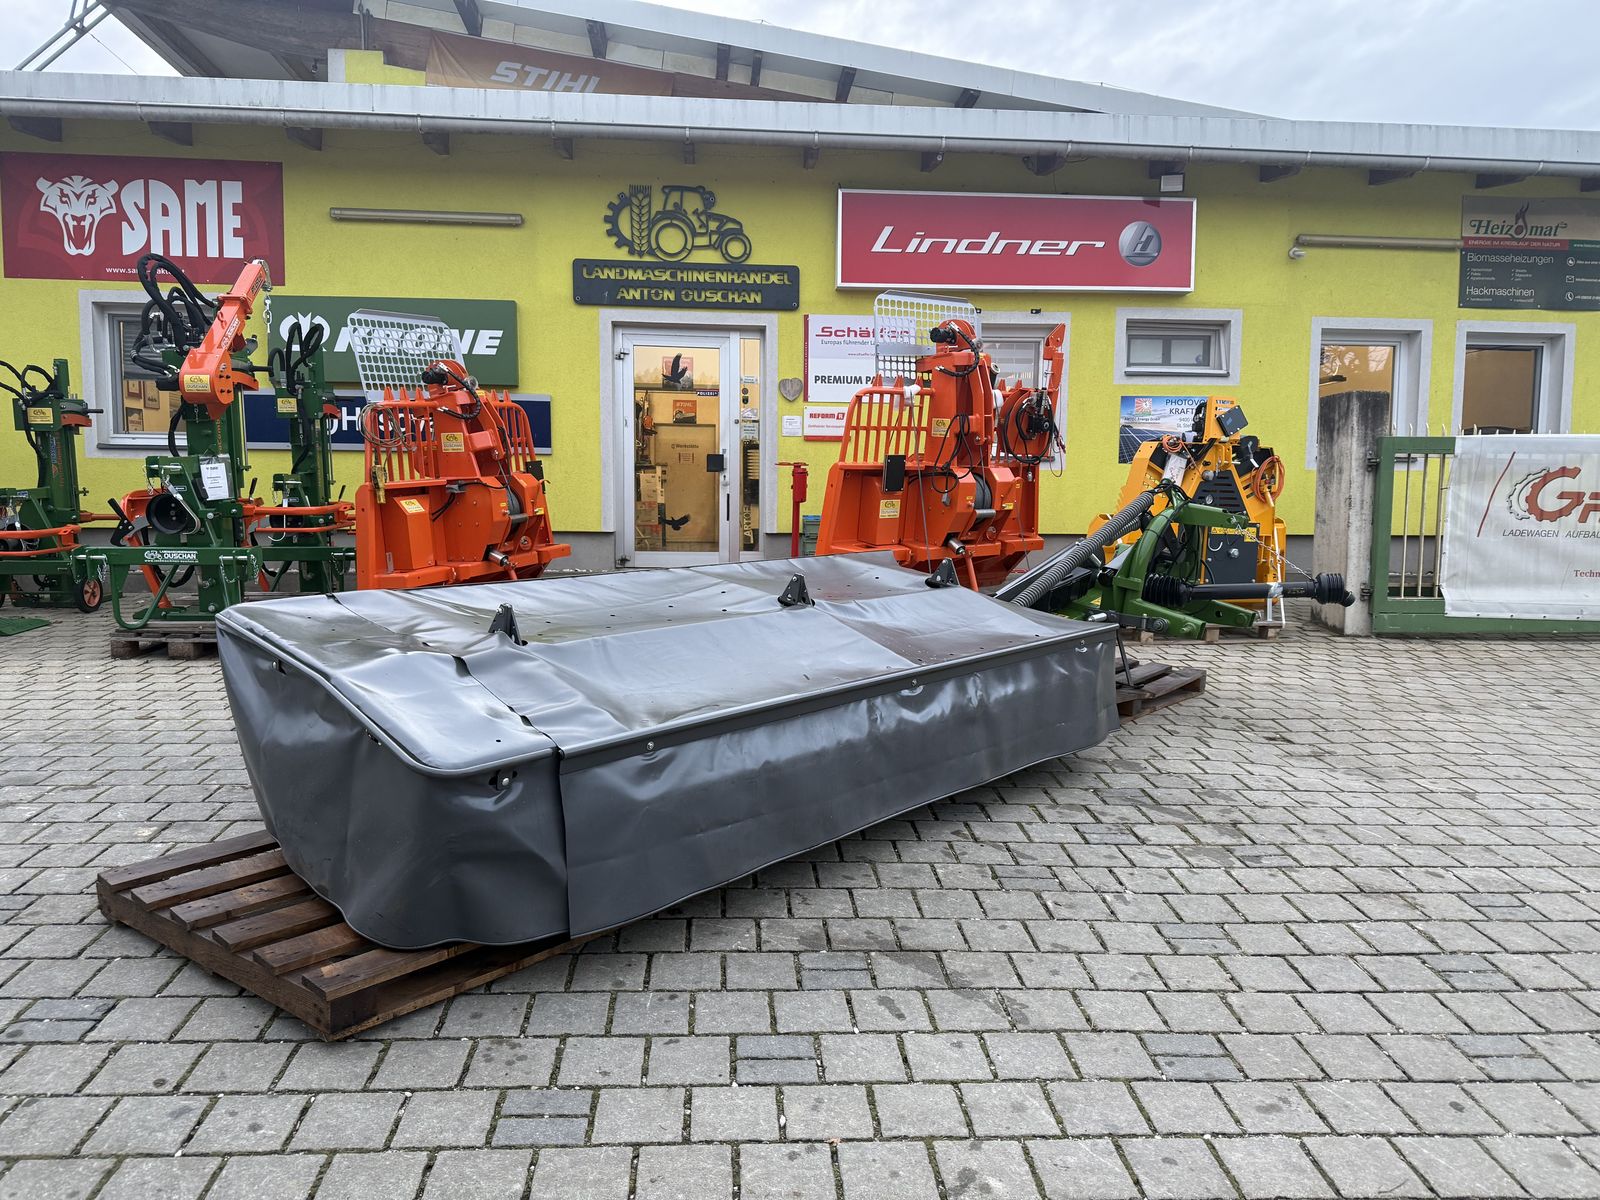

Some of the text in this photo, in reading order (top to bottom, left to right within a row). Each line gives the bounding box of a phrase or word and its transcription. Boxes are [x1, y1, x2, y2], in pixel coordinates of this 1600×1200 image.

[489, 60, 600, 93] STIHL
[121, 178, 244, 259] SAME
[1469, 214, 1566, 239] Heizomat
[870, 225, 1105, 256] Lindner
[1467, 252, 1554, 265] Biomasseheizungen
[582, 266, 792, 285] LANDMASCHINENHANDEL
[616, 287, 762, 304] ANTON OUSCHAN
[1466, 286, 1535, 297] Hackmaschinen
[814, 375, 863, 385] PREMIUM
[1169, 407, 1194, 415] KRAFT
[1502, 529, 1559, 538] LADEWAGEN
[1574, 569, 1600, 578] Techn
